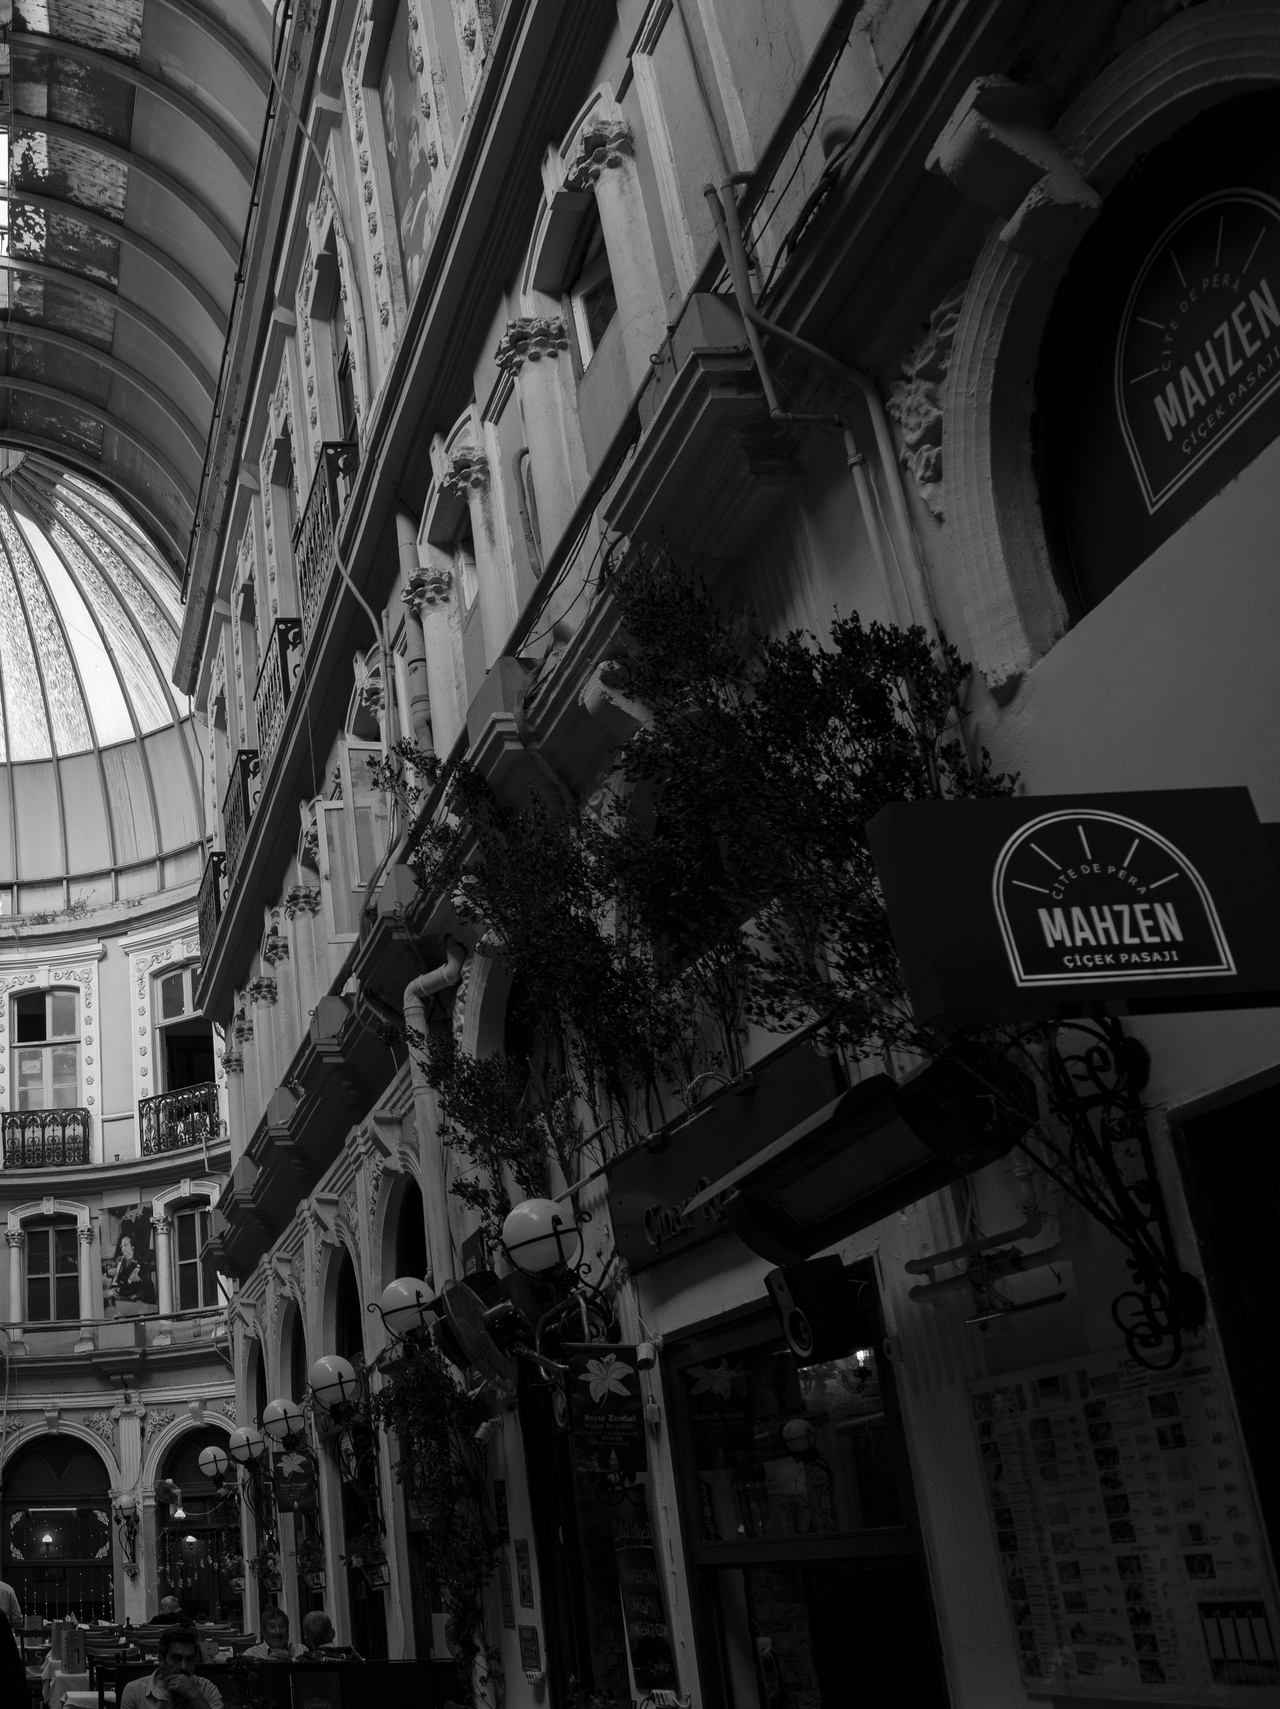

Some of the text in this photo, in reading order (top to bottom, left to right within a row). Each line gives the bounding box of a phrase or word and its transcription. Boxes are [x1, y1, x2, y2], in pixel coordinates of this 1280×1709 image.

[1179, 288, 1198, 314] DE
[1202, 273, 1240, 293] PERA
[1154, 278, 1280, 442] MAHZEN
[1228, 345, 1280, 406] PASAJI
[1080, 863, 1102, 875] DE
[1107, 865, 1148, 895] PERA
[1037, 902, 1184, 948] MAHZEN
[1062, 950, 1179, 968] ÇİÇEK PASAJI
[585, 1413, 637, 1423] Beyaz Zambak
